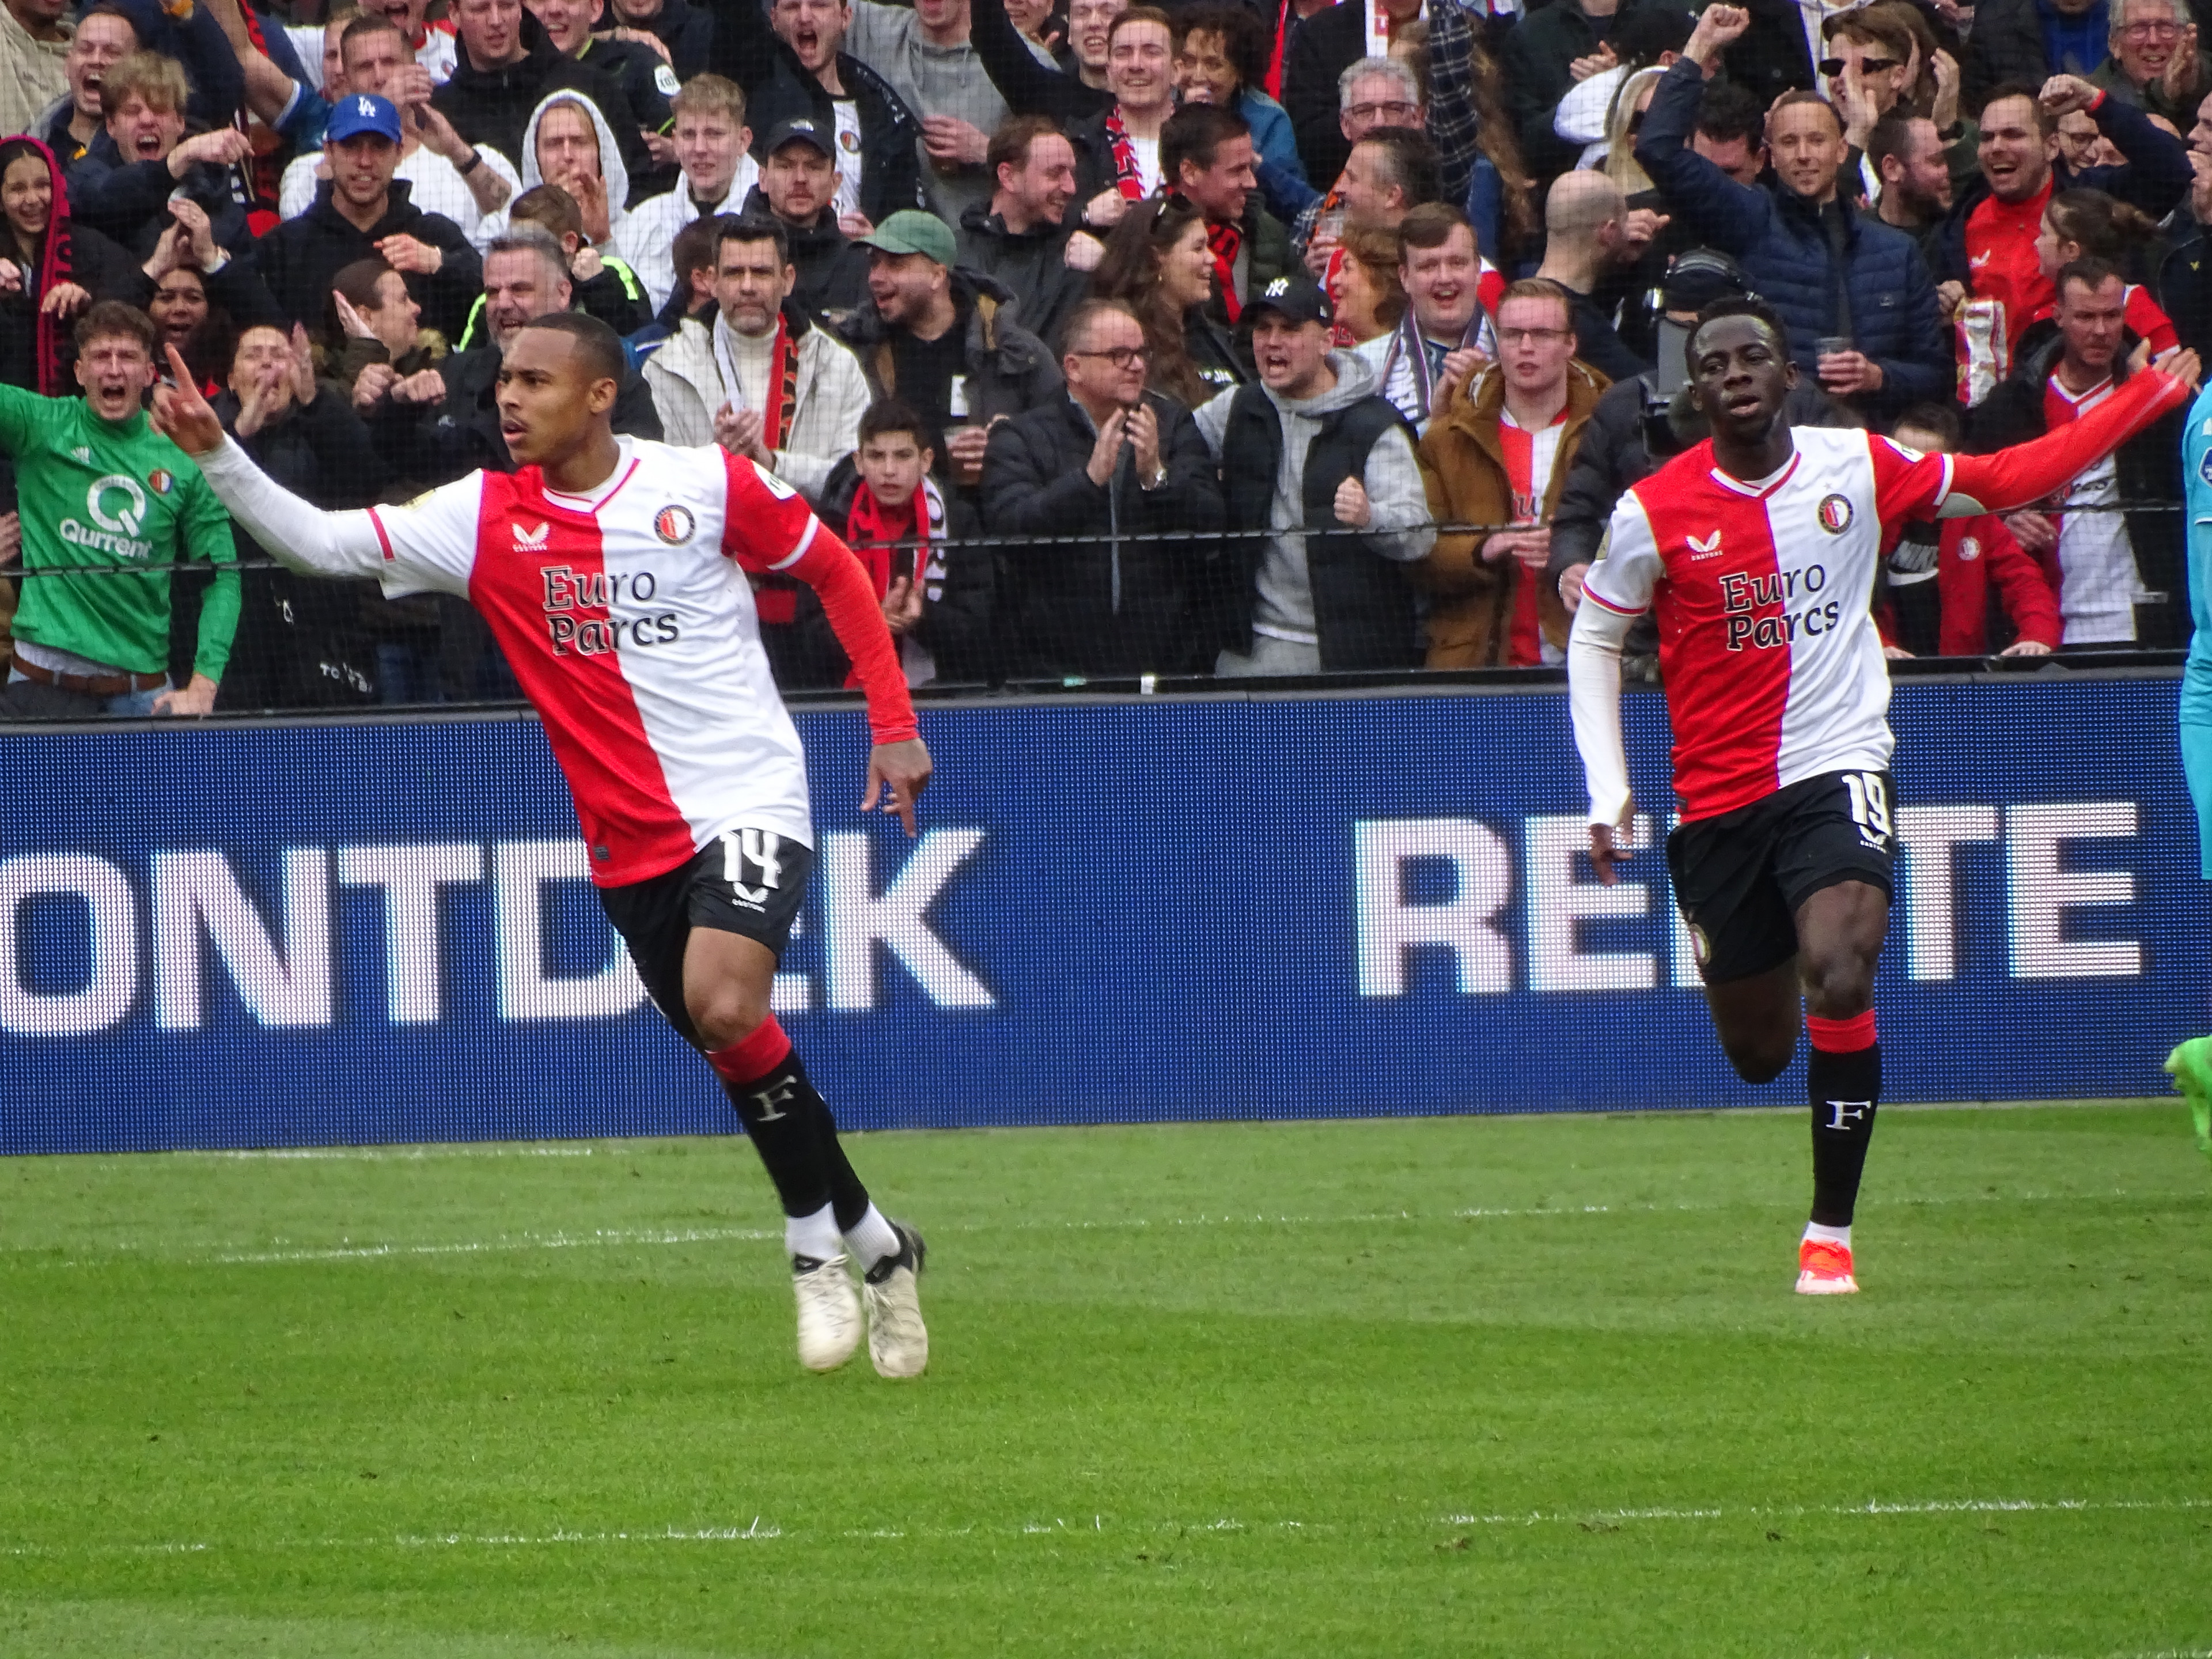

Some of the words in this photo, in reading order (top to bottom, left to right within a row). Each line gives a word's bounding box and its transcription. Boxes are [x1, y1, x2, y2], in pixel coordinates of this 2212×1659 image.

[1266, 278, 1289, 297] NY
[59, 518, 152, 558] Qurrent
[540, 565, 655, 612] Euro
[1719, 565, 1825, 613] Euro
[546, 613, 679, 656] Parcs
[1725, 600, 1839, 652] Parcs
[1842, 772, 1892, 836] 19
[719, 828, 782, 889] 14
[0, 828, 997, 1036] ONTDK
[1355, 802, 2142, 998] RETE
[750, 1075, 797, 1122] F
[1825, 1101, 1871, 1130] F
